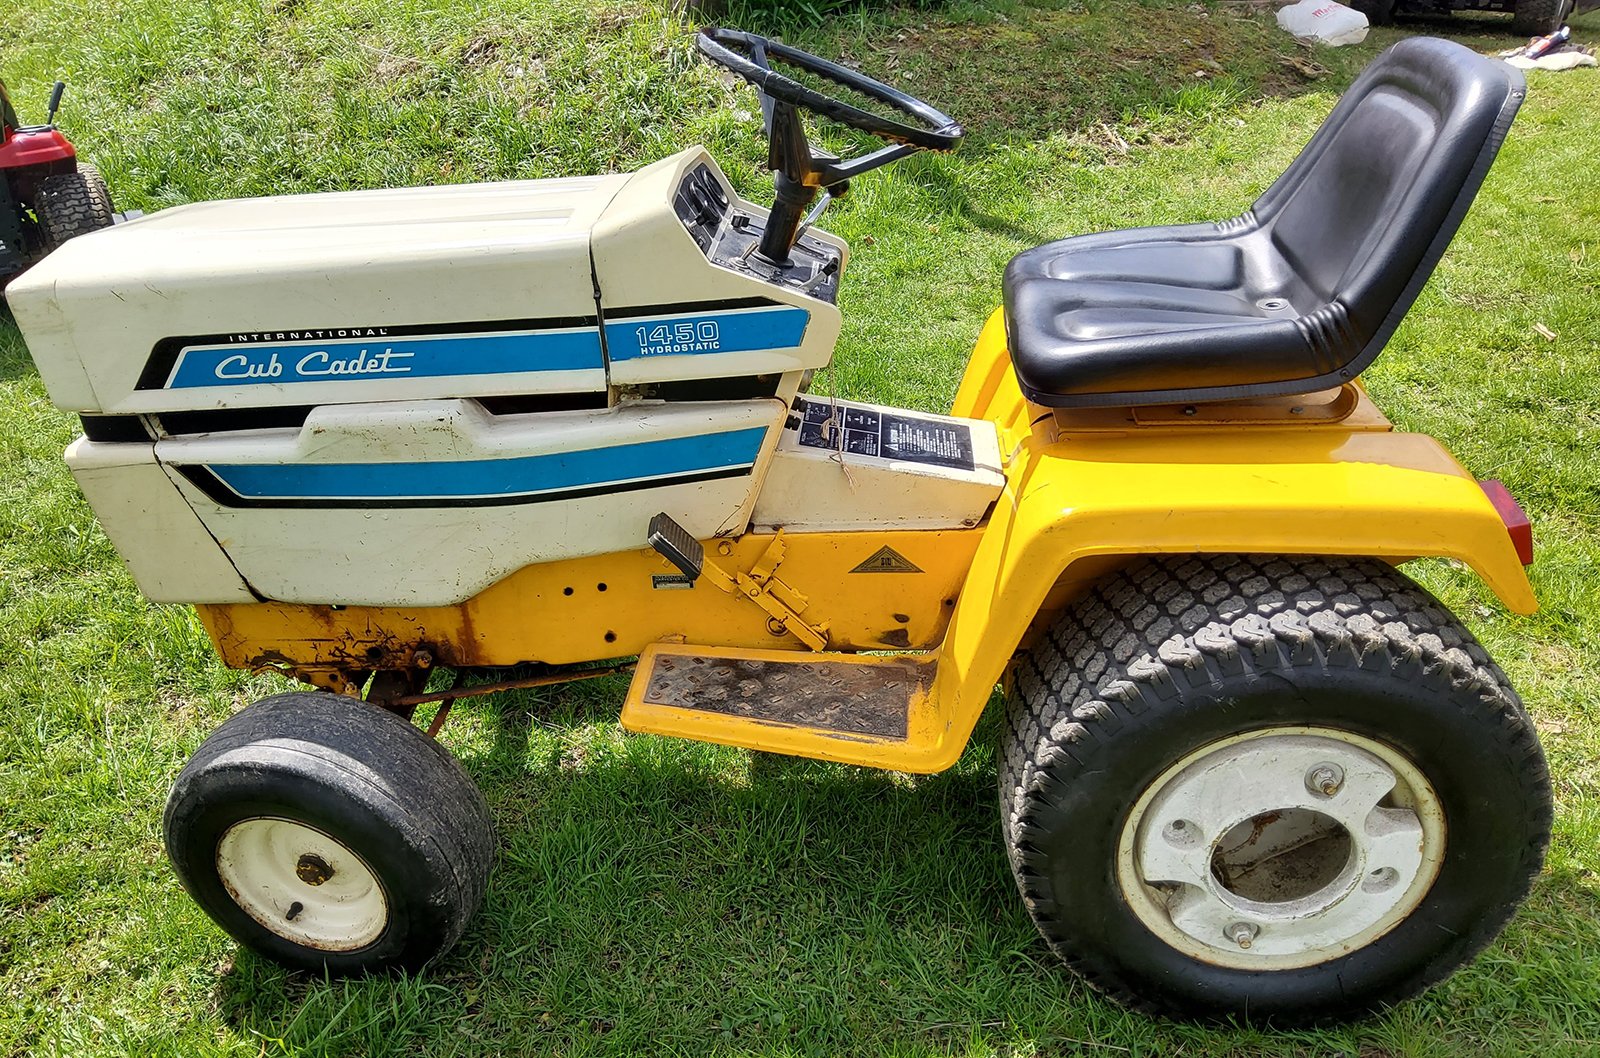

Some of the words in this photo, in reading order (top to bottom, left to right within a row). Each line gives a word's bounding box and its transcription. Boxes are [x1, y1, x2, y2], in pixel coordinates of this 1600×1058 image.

[229, 328, 387, 342] INTERNATIONAL
[636, 320, 720, 347] 1450
[640, 341, 720, 355] HYDROSTATIC
[214, 353, 283, 379] Cub
[295, 348, 415, 376] Cadet
